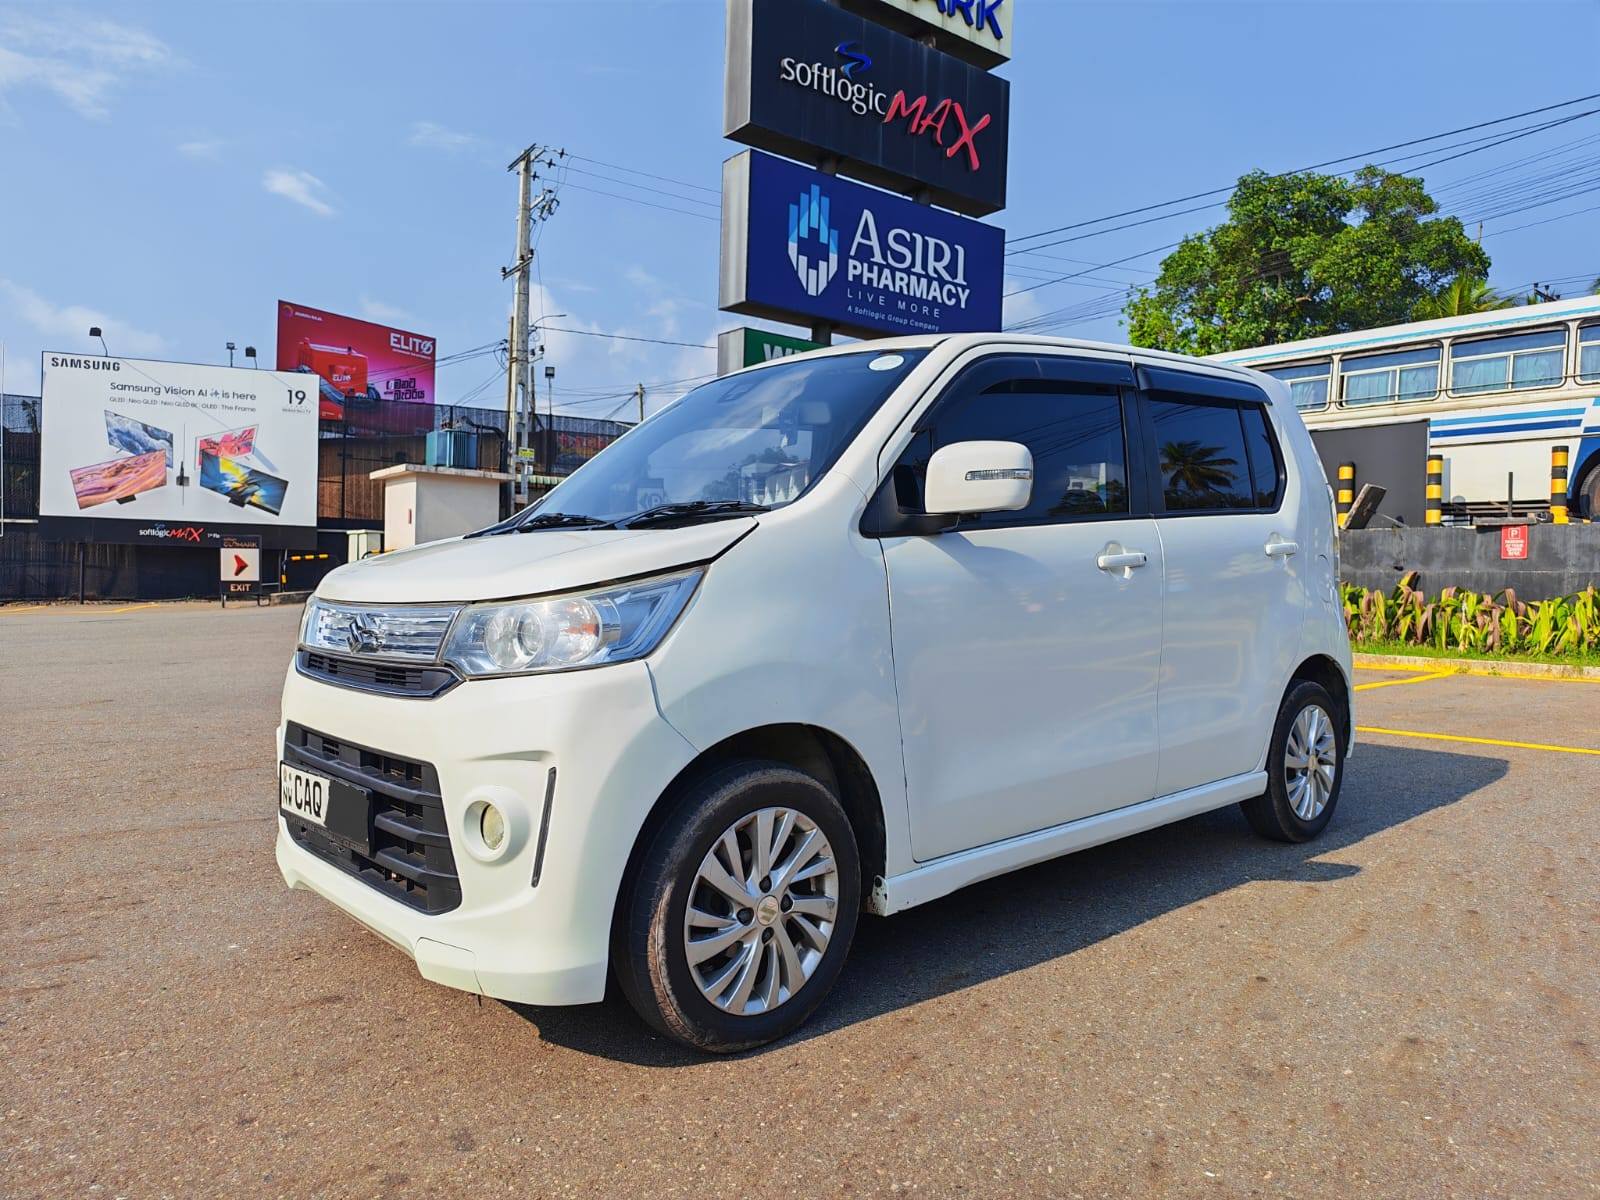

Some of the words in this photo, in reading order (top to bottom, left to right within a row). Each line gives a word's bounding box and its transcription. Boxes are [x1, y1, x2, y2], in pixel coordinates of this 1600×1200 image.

[780, 57, 887, 115] softlogic
[882, 90, 991, 171] MAX
[849, 208, 967, 285] ASIRI
[847, 258, 970, 309] PHARMACY
[847, 288, 886, 306] LIVE
[897, 300, 940, 318] MORE
[847, 305, 852, 313] A
[854, 306, 886, 320] Softlogic
[887, 313, 908, 325] Group
[909, 319, 939, 332] Company
[51, 357, 121, 371] SAMSUNG
[110, 382, 161, 396] Samsung
[164, 385, 195, 397] Vision
[198, 389, 208, 397] AI
[222, 390, 230, 399] is
[232, 391, 257, 401] here
[287, 389, 306, 405] 19
[139, 528, 171, 538] softlogic
[169, 527, 204, 542] MAX
[1510, 529, 1518, 539] P
[230, 583, 251, 592] EXIT
[294, 775, 322, 818] CAQ
